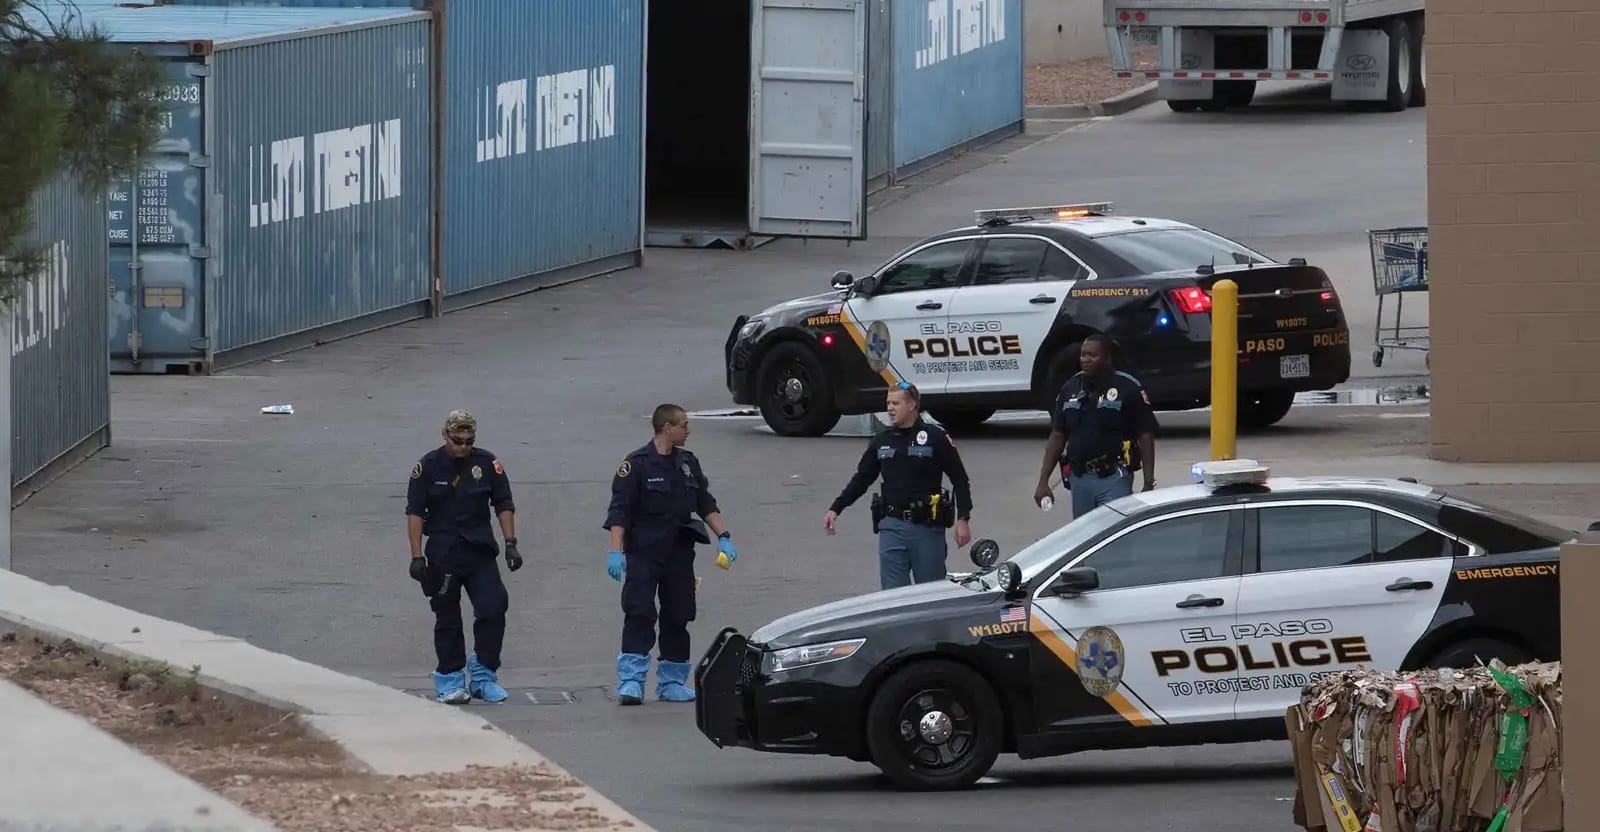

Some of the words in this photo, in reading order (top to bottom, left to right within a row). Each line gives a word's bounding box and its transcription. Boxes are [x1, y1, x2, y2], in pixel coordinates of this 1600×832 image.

[476, 79, 527, 163] LLOYD
[249, 136, 304, 228] LLOYD
[109, 192, 128, 201] TARE
[108, 210, 124, 220] NET
[109, 229, 129, 239] CUBE
[1071, 288, 1130, 297] EMERGENCY
[1132, 287, 1149, 296] 911
[807, 315, 840, 326] W18075
[920, 323, 945, 335] EL
[947, 320, 1002, 334] PASO
[903, 334, 1022, 359] POLICE
[1246, 338, 1286, 353] PASO
[1313, 331, 1348, 347] POLICE
[912, 362, 926, 374] TO
[927, 361, 968, 373] PROTECT
[969, 360, 988, 372] AND
[988, 359, 1020, 371] SERVE
[1456, 564, 1557, 580] EMERGENCY
[968, 621, 1027, 637] W18077
[1180, 627, 1226, 643] EL
[1231, 619, 1333, 640] PASO
[1151, 636, 1373, 677] POLICE
[1168, 682, 1193, 696] TO
[1194, 675, 1270, 694] PROTECT
[1273, 672, 1307, 690] AND
